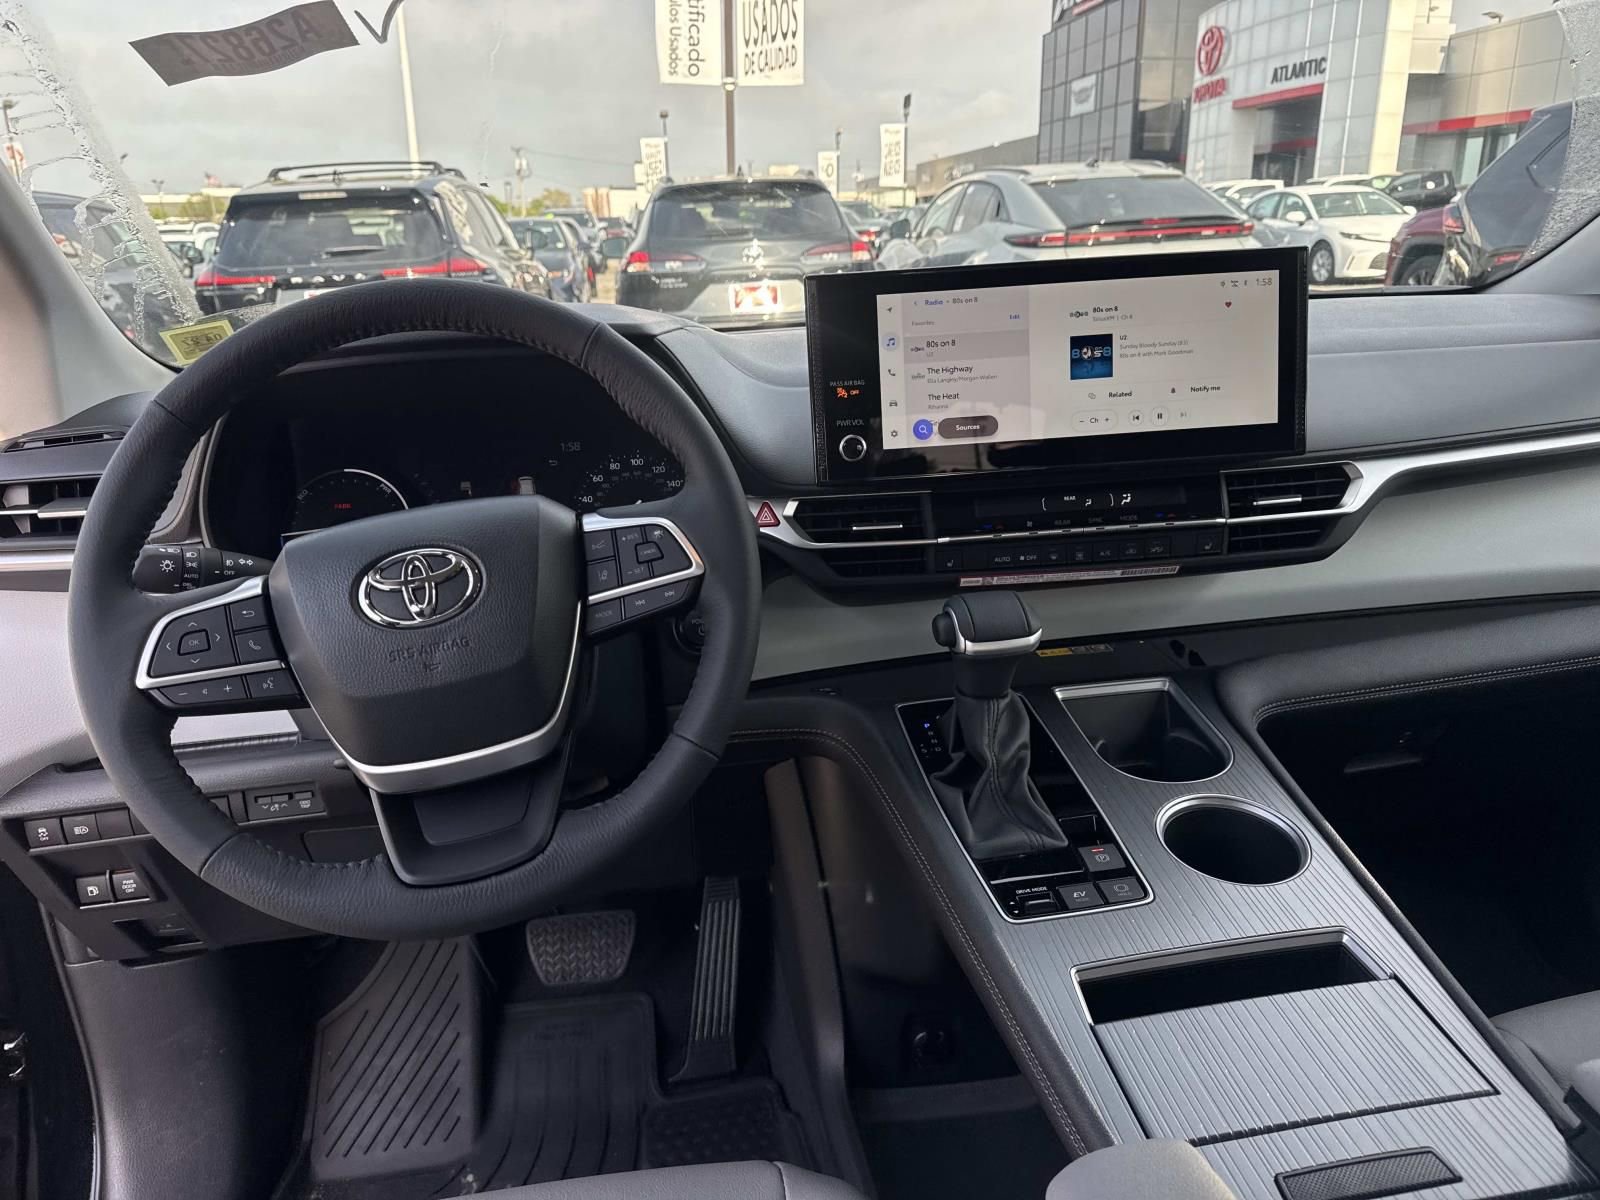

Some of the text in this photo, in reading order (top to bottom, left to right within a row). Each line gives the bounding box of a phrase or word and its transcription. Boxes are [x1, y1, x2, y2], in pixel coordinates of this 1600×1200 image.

[743, 0, 798, 48] USADOS
[668, 26, 682, 76] Usados
[744, 44, 798, 76] DE CALIDAD
[1271, 56, 1327, 84] ATLANTIC
[1256, 277, 1272, 286] 1:58
[926, 340, 939, 348] 80s
[950, 339, 956, 347] 8
[927, 364, 973, 375] The Highway
[1190, 385, 1208, 393] Notify
[928, 392, 959, 401] The Heat
[1108, 390, 1132, 398] Related
[955, 423, 981, 431] Sources
[560, 441, 581, 452] 1:58
[609, 462, 621, 471] 80
[630, 458, 644, 466] 100
[651, 465, 666, 474] 120
[592, 474, 604, 483] 60
[666, 480, 682, 488] 140
[581, 496, 593, 504] 40
[188, 639, 200, 647] OK
[1073, 890, 1086, 898] EV
